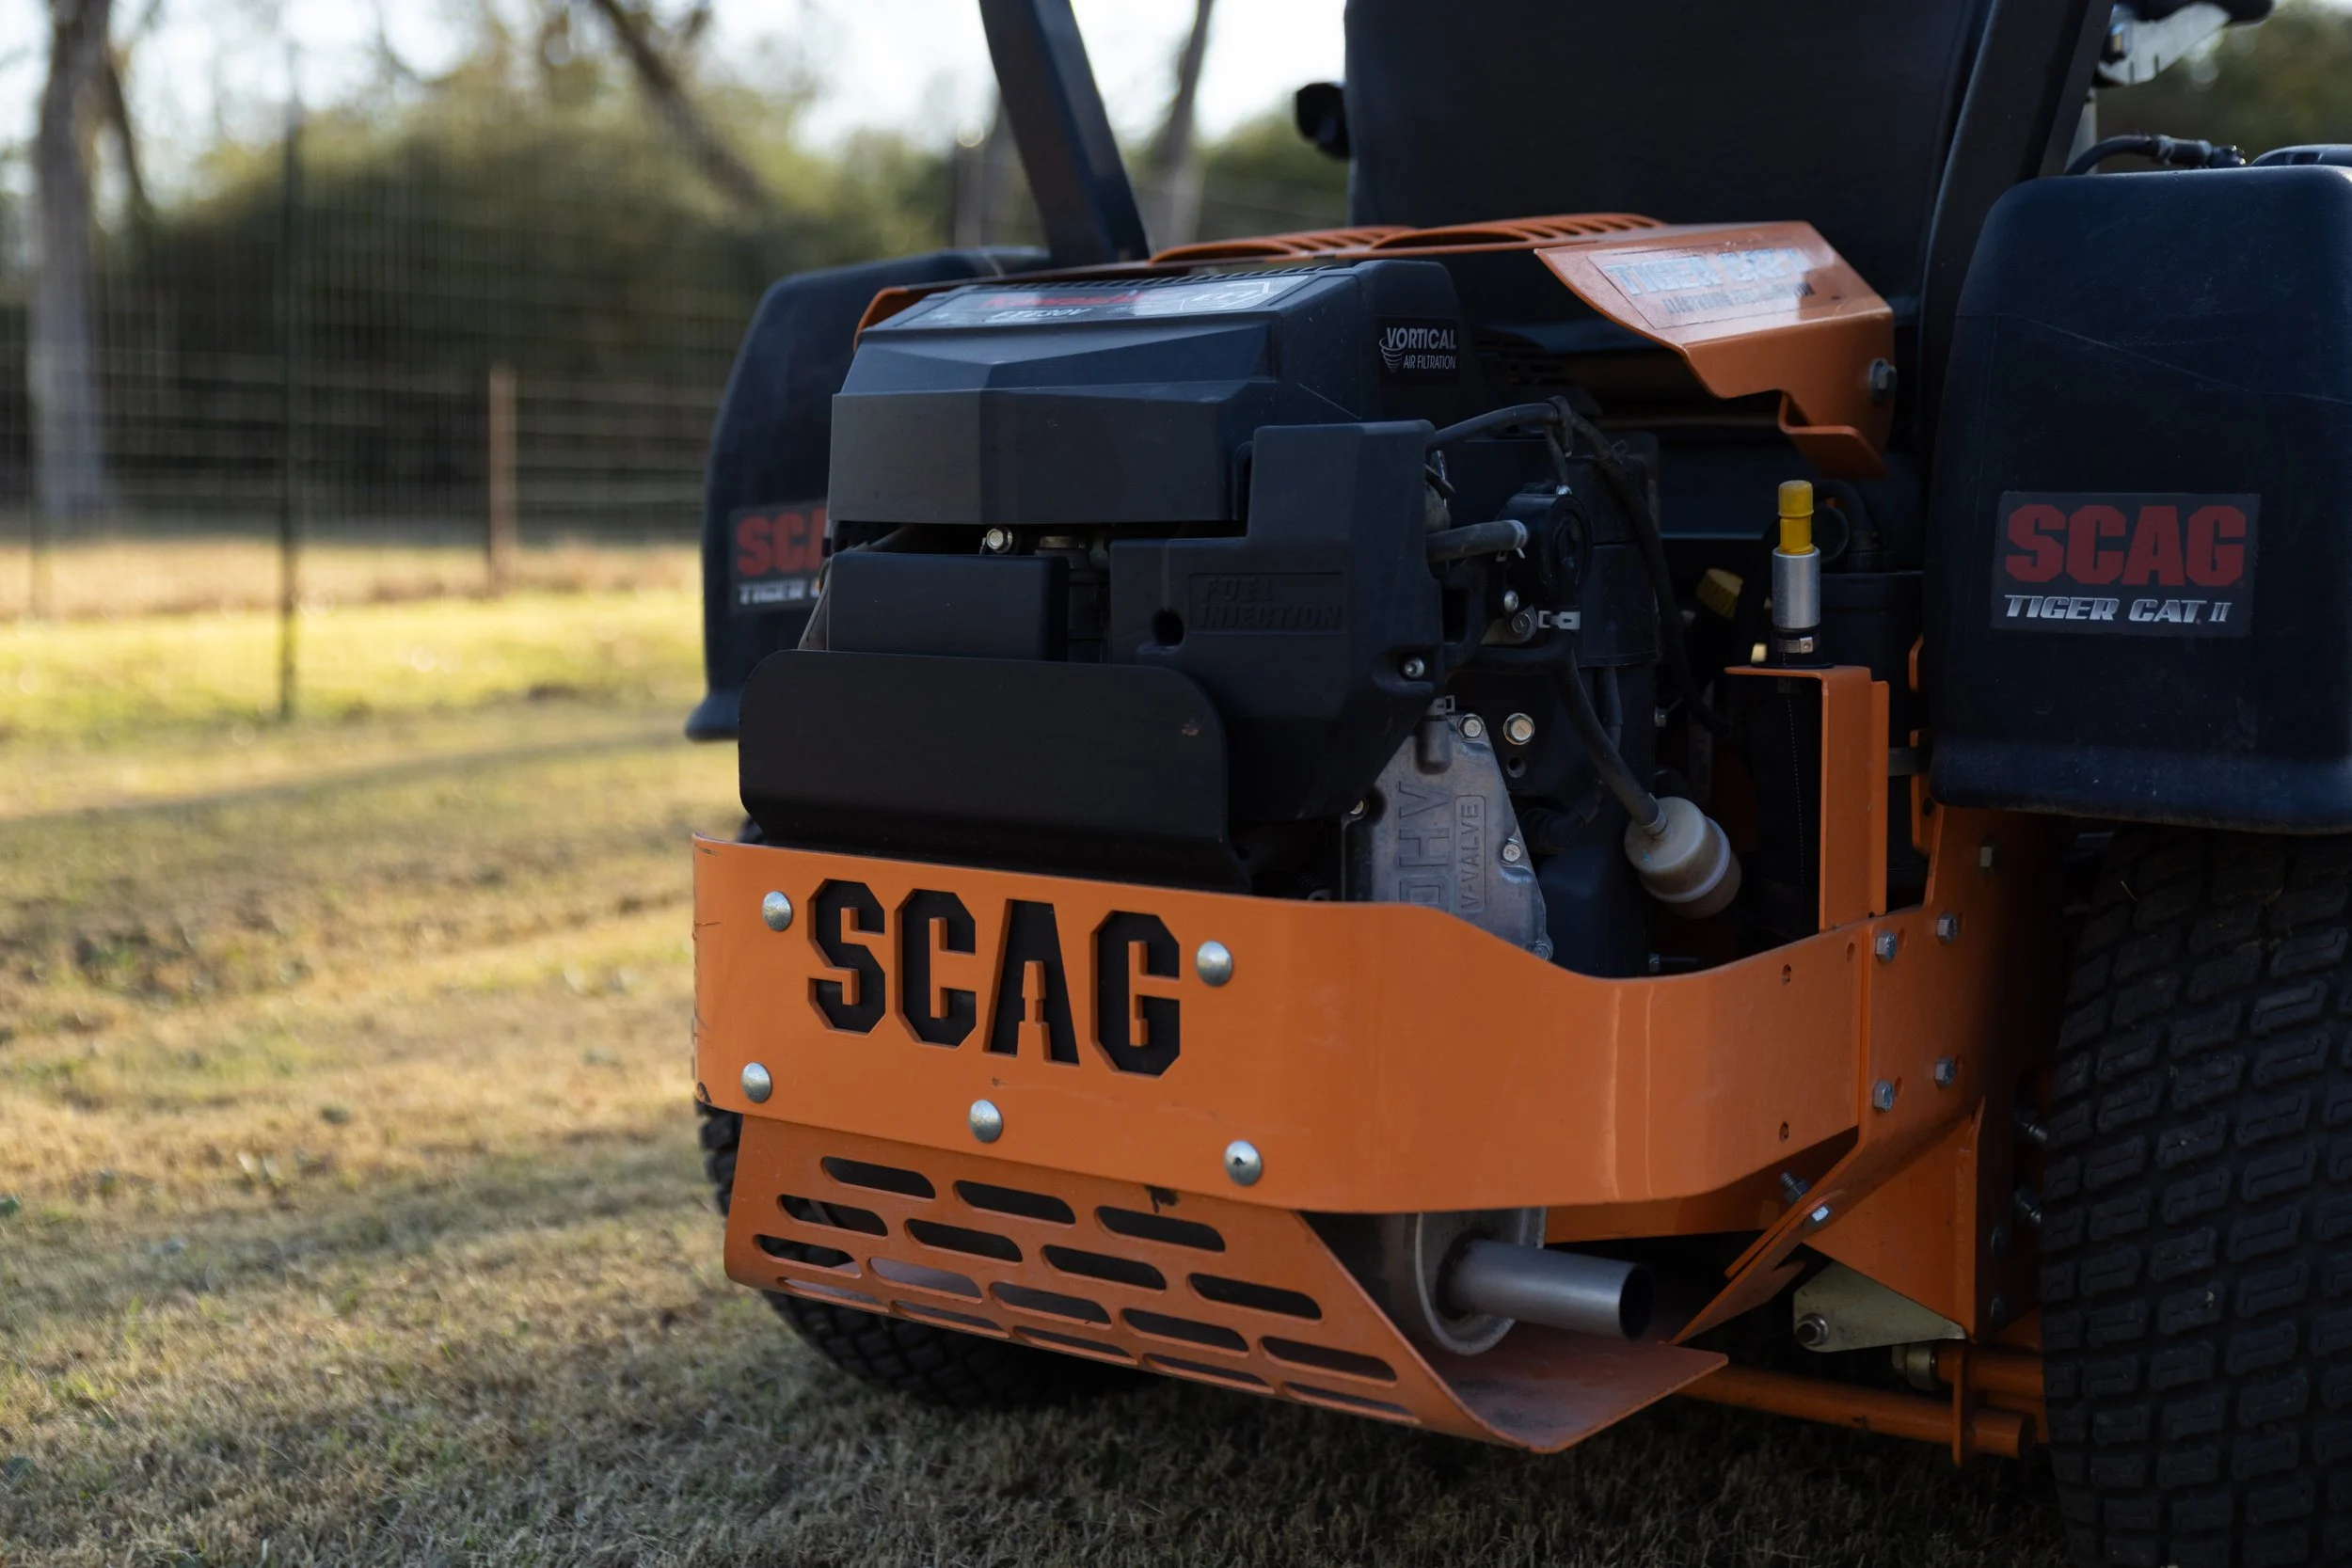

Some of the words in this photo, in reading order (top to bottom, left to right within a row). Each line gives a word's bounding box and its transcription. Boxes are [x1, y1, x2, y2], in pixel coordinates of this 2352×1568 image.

[1386, 327, 1457, 350] VORTICAL
[1403, 355, 1416, 369] AIR
[1417, 355, 1456, 370] FILTRATION
[2005, 504, 2247, 587] SCAG
[1201, 577, 1276, 602] FUEL
[1197, 602, 1343, 628] INJECTION
[2004, 594, 2120, 621] TIGER
[2128, 598, 2207, 624] CAT
[2208, 602, 2233, 623] II
[1460, 803, 1480, 910] V-VALVE
[807, 878, 1181, 1080] SCAG
